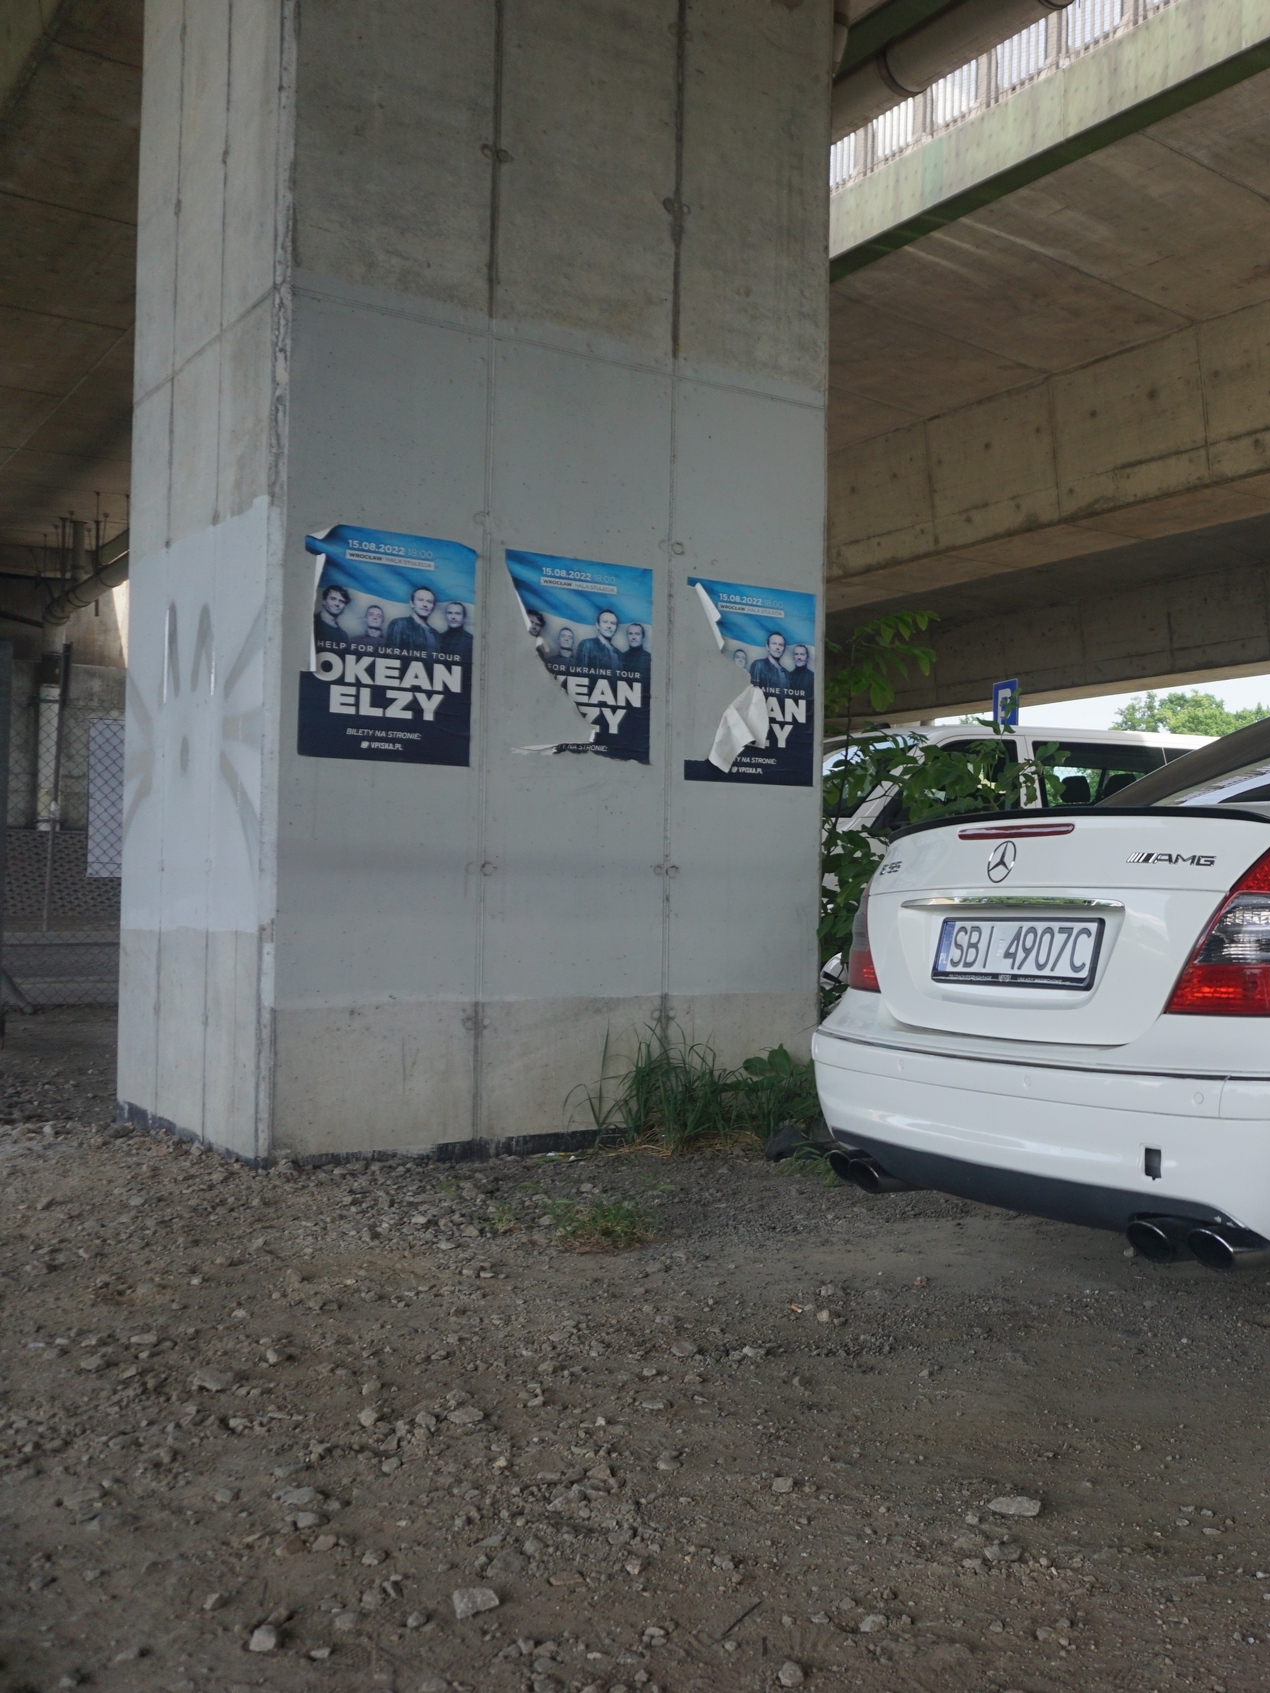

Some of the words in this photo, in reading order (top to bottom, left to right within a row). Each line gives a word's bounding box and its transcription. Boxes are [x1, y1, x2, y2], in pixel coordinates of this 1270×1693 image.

[348, 540, 405, 555] 15.08.2022
[408, 549, 434, 559] 18:00
[349, 552, 383, 561] WROCŁAW
[542, 567, 592, 580] 15.08.2022
[594, 574, 616, 583] 18:00
[719, 593, 762, 605] 15.08.2022
[764, 599, 783, 608] 18:00
[317, 640, 347, 650] HELP
[351, 643, 374, 653] FOR
[379, 647, 428, 659] UKRAINE
[432, 652, 461, 662] TOUR
[313, 651, 462, 693] OKEAN
[570, 666, 612, 676] UKRAINE
[616, 670, 640, 679] TOUR
[784, 688, 805, 696] TOUR
[329, 684, 445, 721] ELZY
[346, 728, 374, 737] BILETY
[375, 730, 386, 738] NA
[1153, 853, 1216, 867] AMG
[950, 925, 994, 968] SBI
[1003, 926, 1092, 973] 4907C
[938, 952, 947, 965] PL
